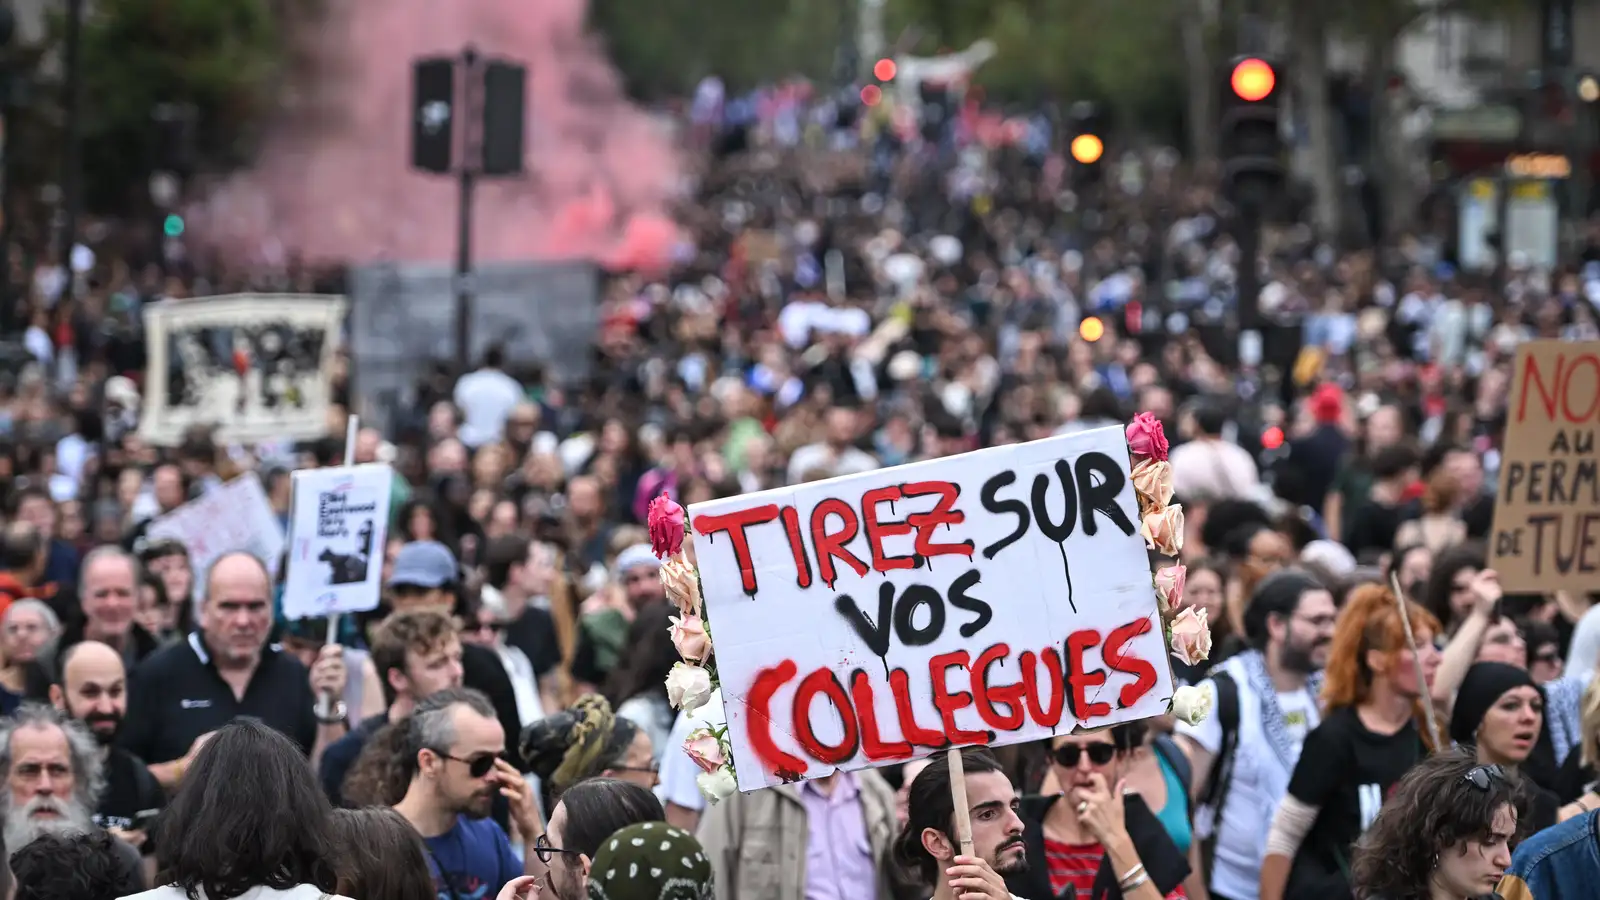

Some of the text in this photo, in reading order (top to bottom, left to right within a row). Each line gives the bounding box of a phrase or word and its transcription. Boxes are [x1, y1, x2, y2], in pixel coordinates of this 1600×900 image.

[1517, 352, 1600, 424] NO
[1549, 427, 1595, 455] AU
[693, 451, 1135, 597] TIREZ SUR
[1496, 528, 1524, 556] DE
[834, 568, 994, 660] VOS
[745, 616, 1158, 777] COLLEGUES
